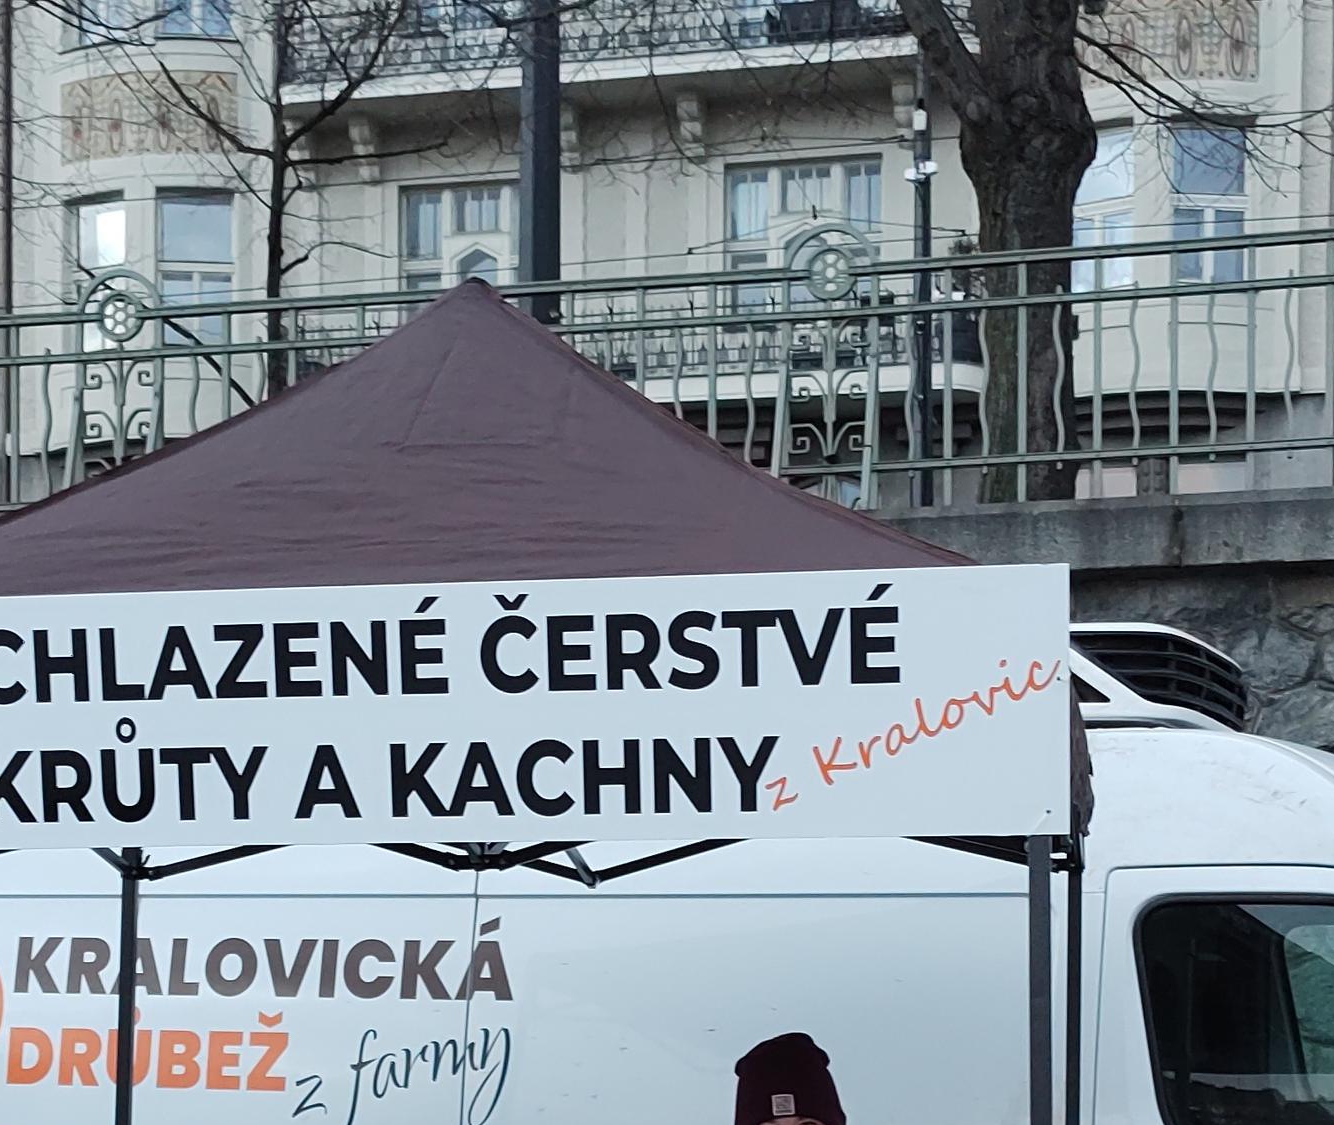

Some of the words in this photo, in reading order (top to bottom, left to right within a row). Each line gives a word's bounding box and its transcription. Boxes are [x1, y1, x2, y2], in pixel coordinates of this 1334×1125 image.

[480, 583, 900, 693] ČERSTVÉ
[295, 744, 362, 819] A
[390, 735, 779, 818] KACHNY
[765, 776, 799, 811] z
[812, 658, 1061, 785] Kralovic
[13, 916, 513, 1001] KRALOVICKÁ
[5, 1007, 289, 1092] DRŮBEŽ
